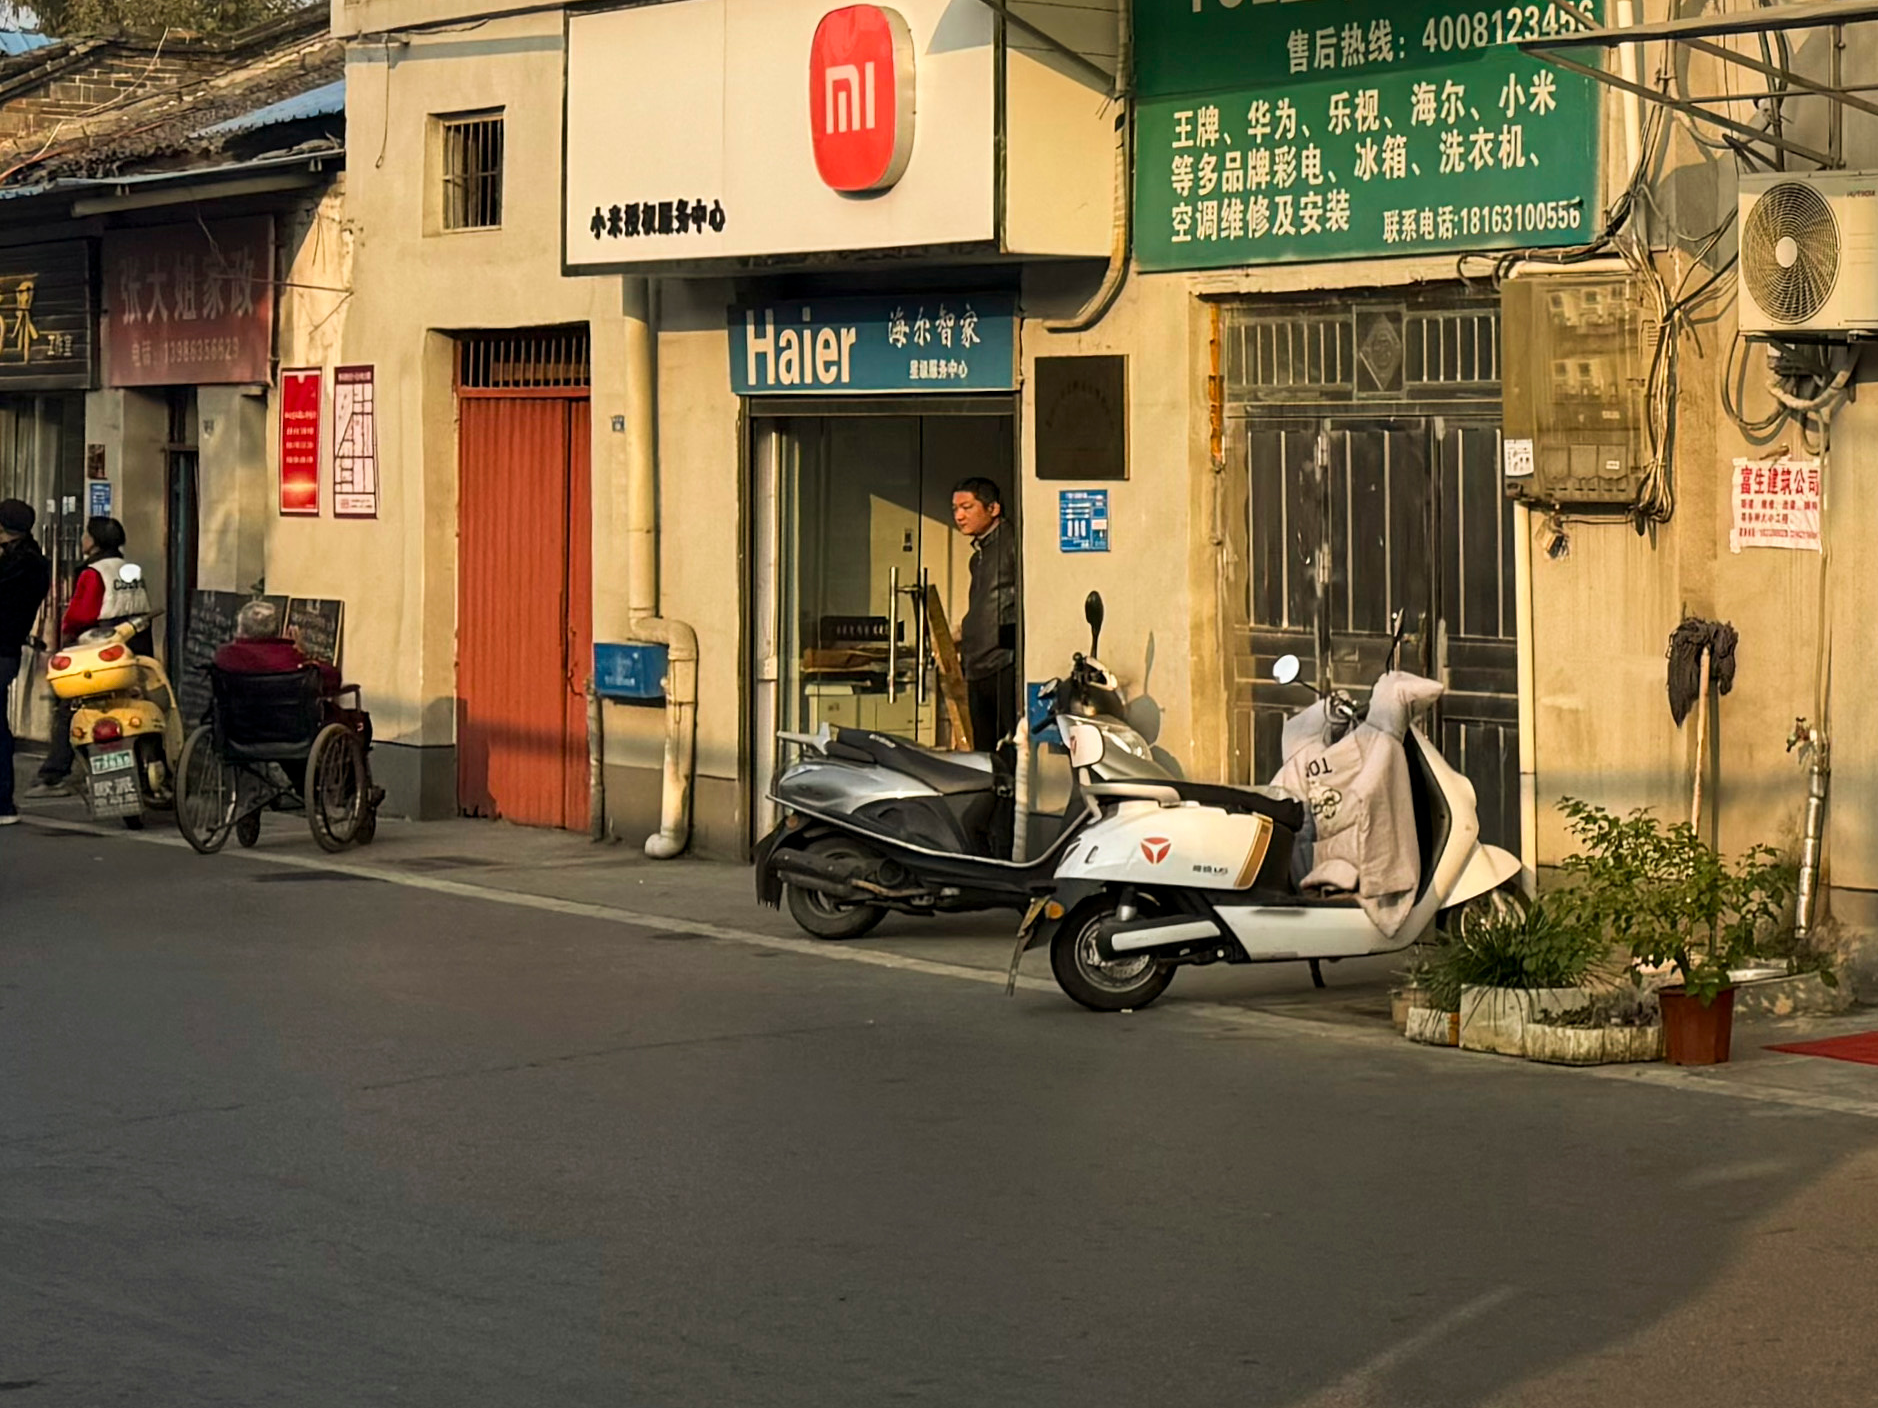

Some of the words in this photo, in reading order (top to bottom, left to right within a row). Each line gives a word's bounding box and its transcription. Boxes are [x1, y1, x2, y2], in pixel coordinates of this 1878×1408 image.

[1287, 18, 1406, 74] 售后热线:
[590, 198, 726, 240] 小米授权服务中心
[1171, 189, 1351, 243] 空调维修及安装
[746, 306, 856, 386] Haier
[888, 303, 981, 349] 海尔智家
